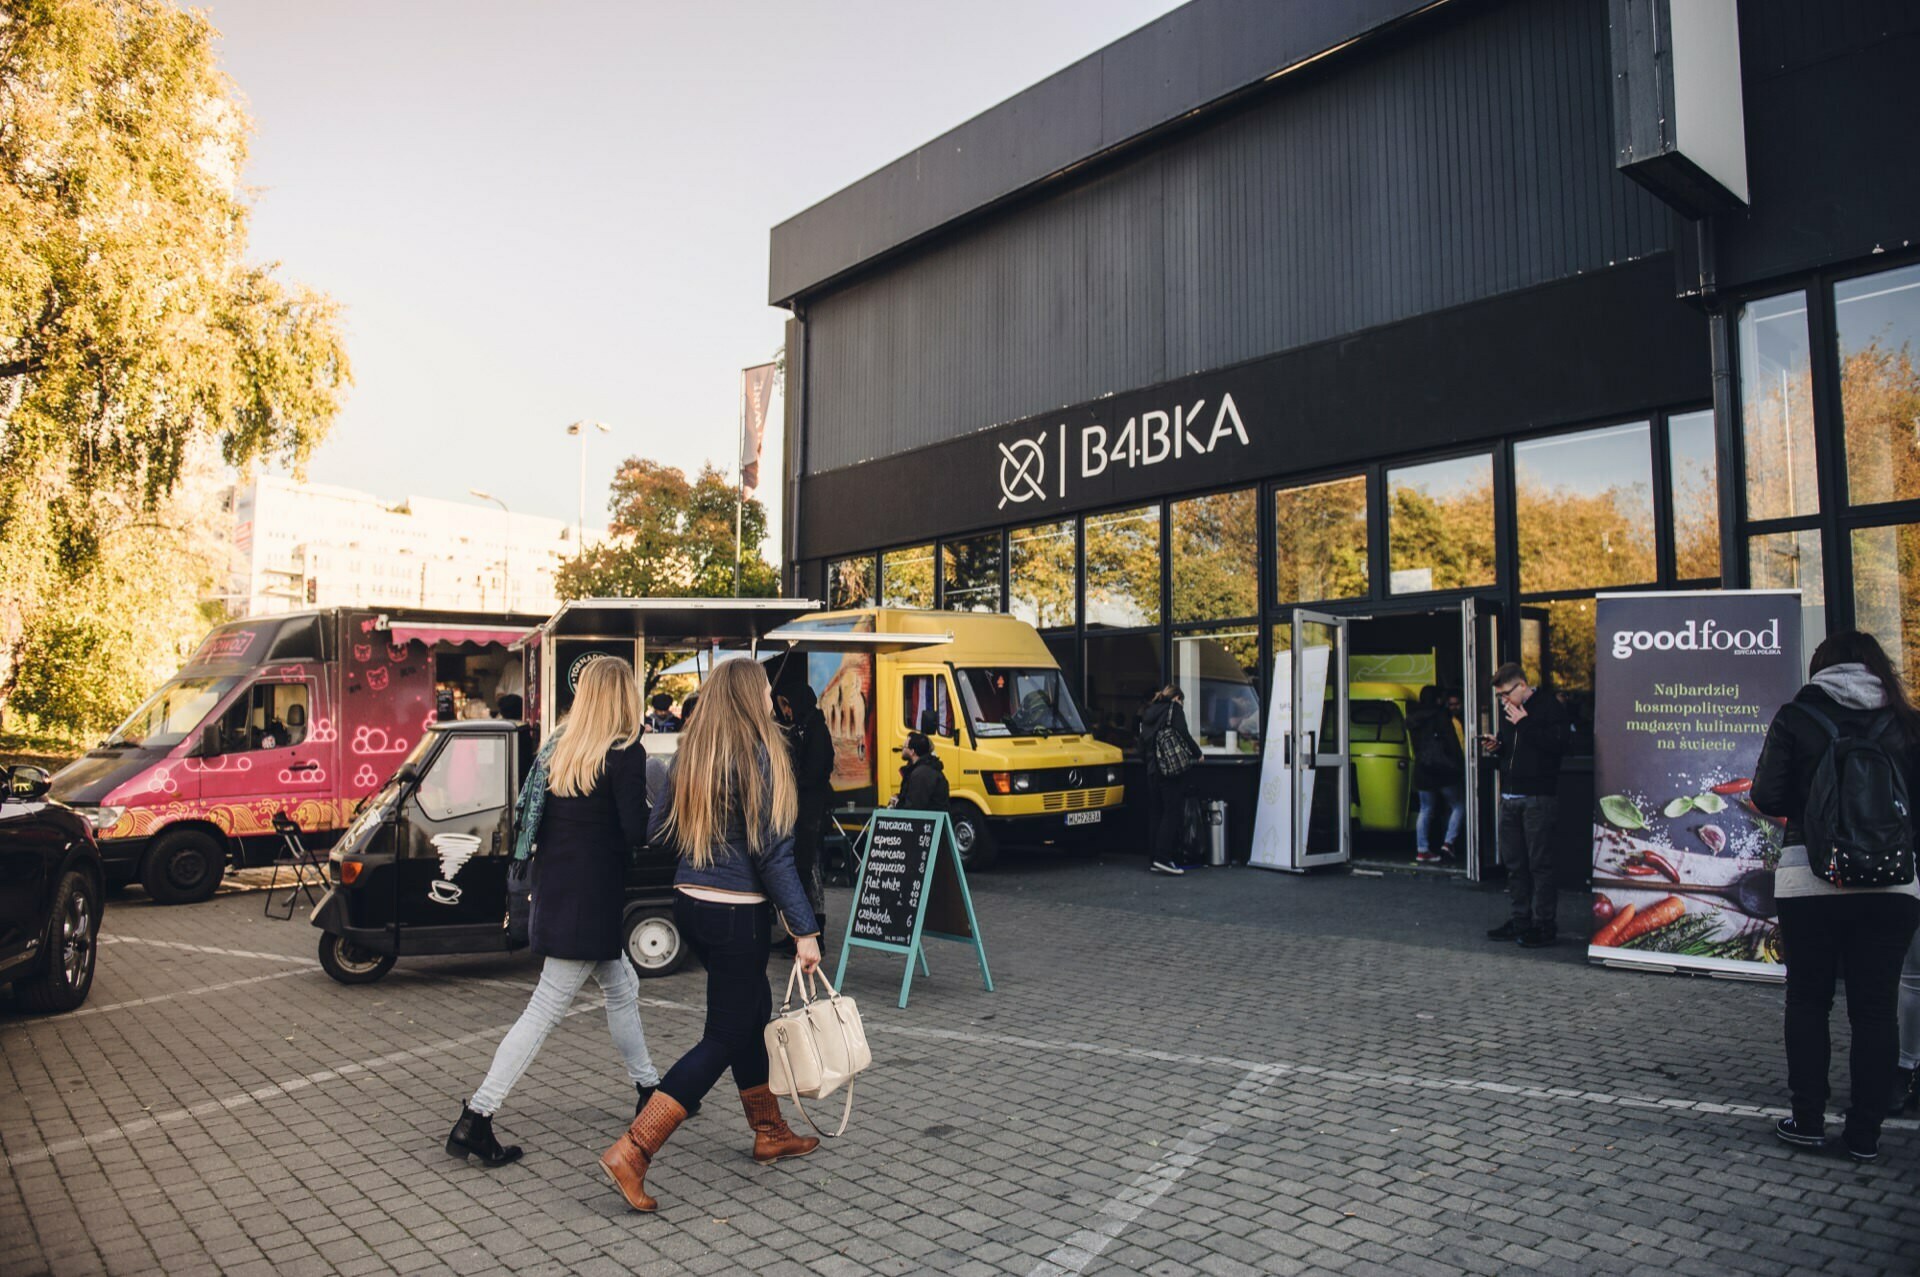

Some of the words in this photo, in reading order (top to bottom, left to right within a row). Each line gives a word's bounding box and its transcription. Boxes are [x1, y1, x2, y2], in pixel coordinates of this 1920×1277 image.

[1082, 392, 1249, 478] B4BKA
[1654, 683, 1739, 699] Najbardziej
[1635, 700, 1760, 717] kosmopolityczny
[1626, 719, 1691, 734] magazyn
[1696, 719, 1769, 736] kulinarny
[1657, 738, 1675, 750] na
[1680, 736, 1736, 750] świecie
[923, 824, 931, 833] 12
[874, 835, 901, 849] espresso
[870, 848, 906, 860] americano
[867, 861, 906, 877] cappuccino
[918, 862, 924, 873] 8
[864, 875, 881, 893] flat
[881, 877, 901, 892] white
[912, 880, 920, 891] 10
[861, 892, 881, 906] latte
[909, 898, 917, 908] 12
[910, 891, 919, 899] 10
[857, 908, 892, 924] czekolada
[906, 914, 913, 928] 6
[855, 920, 883, 936] herbata
